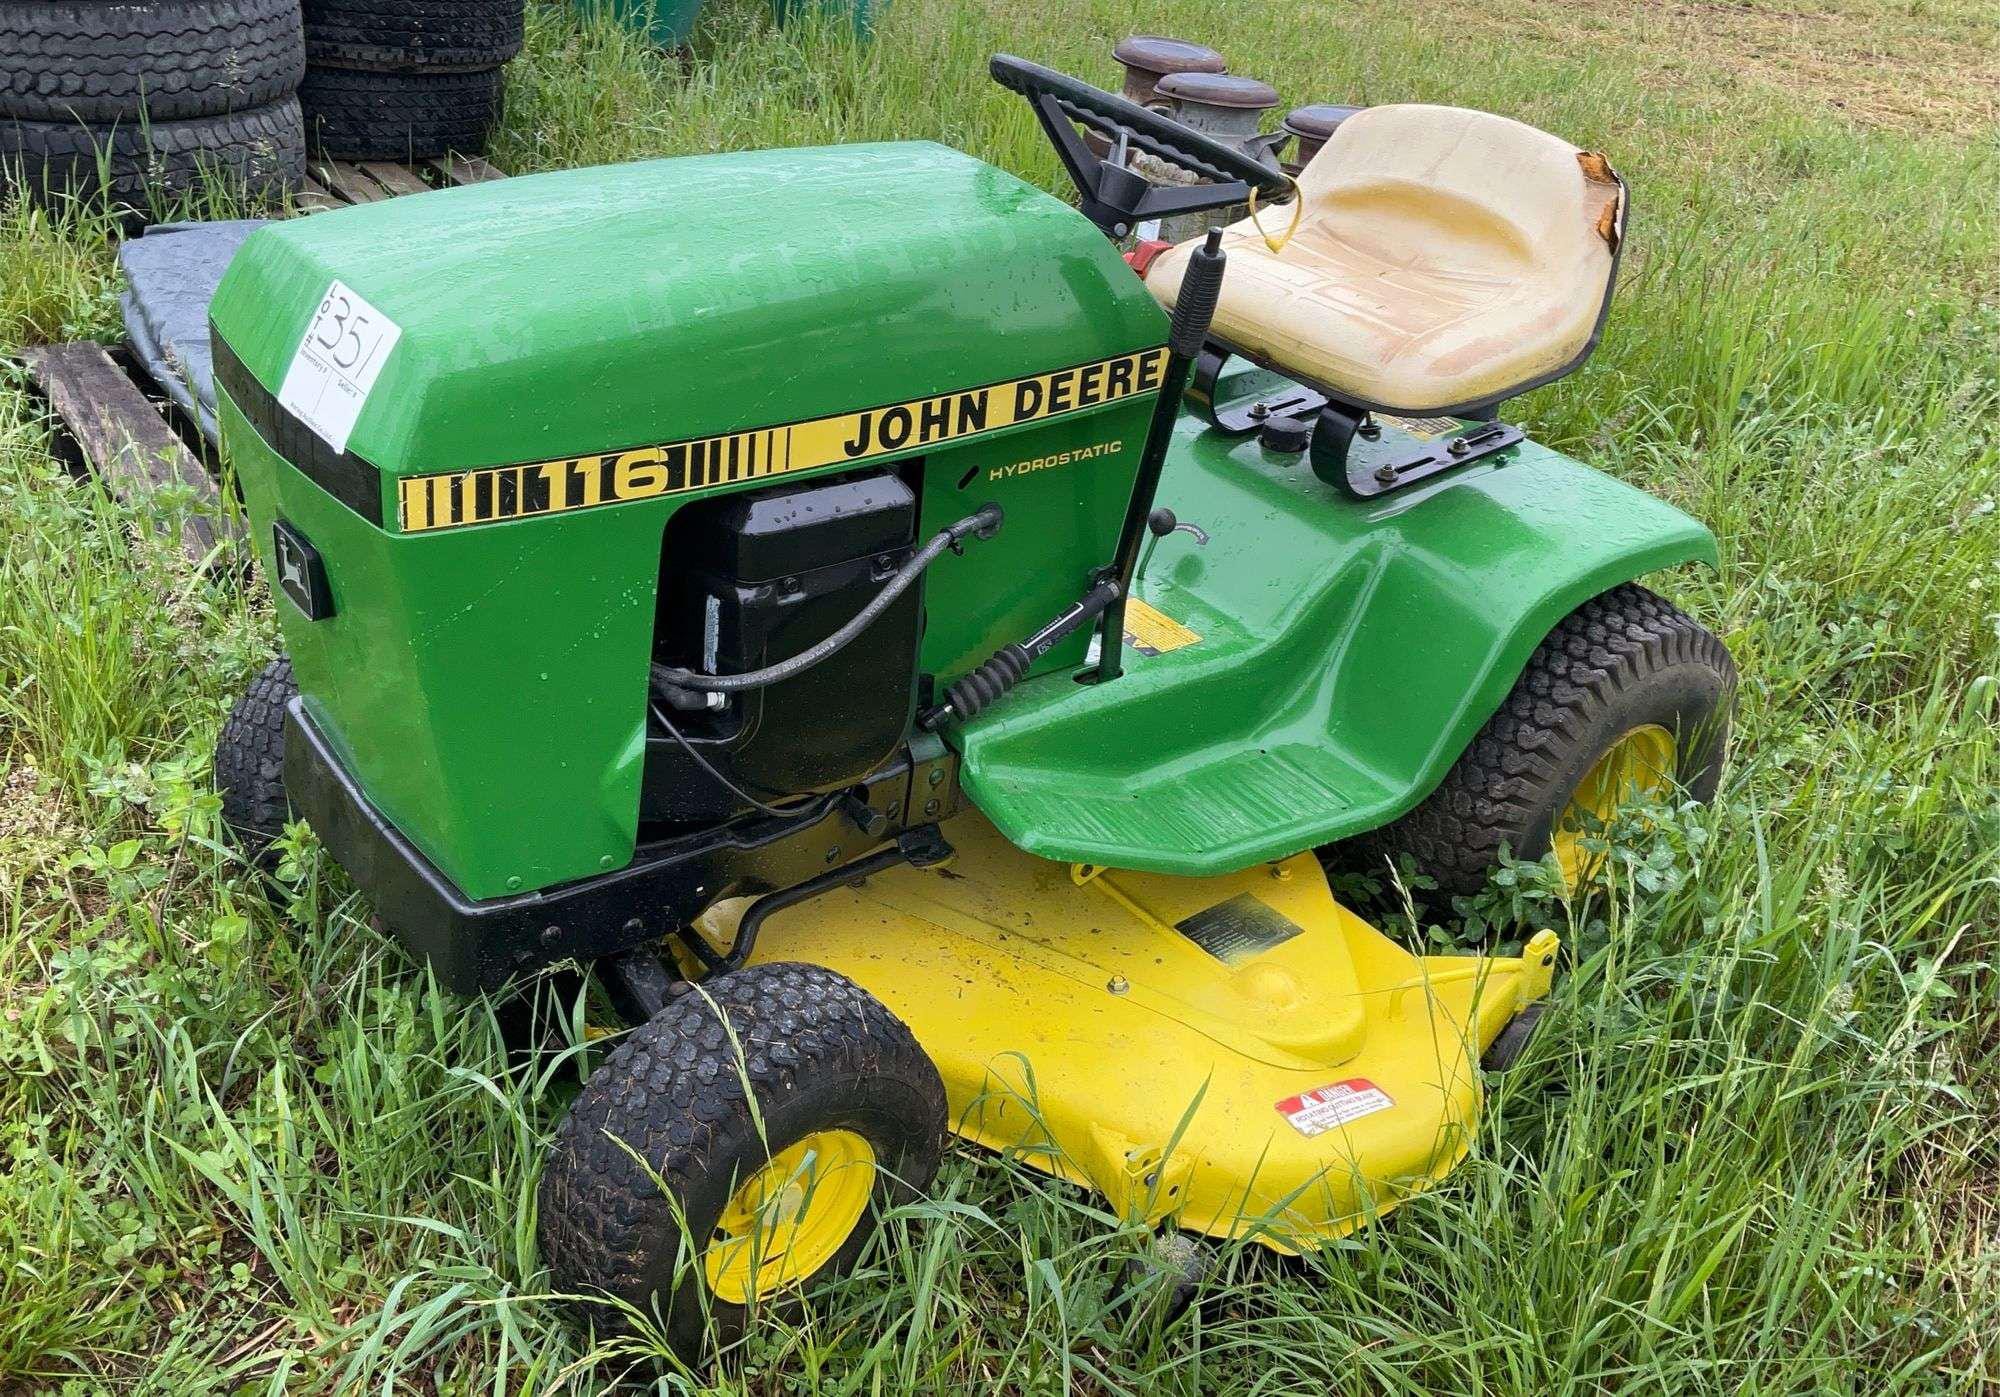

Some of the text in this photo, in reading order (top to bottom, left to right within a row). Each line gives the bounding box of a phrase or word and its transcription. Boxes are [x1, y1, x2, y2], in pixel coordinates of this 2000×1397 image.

[317, 297, 383, 379] 351
[844, 350, 1161, 457] JOHN DEERE
[538, 447, 669, 512] 116
[989, 440, 1122, 481] HYDROSTATIC
